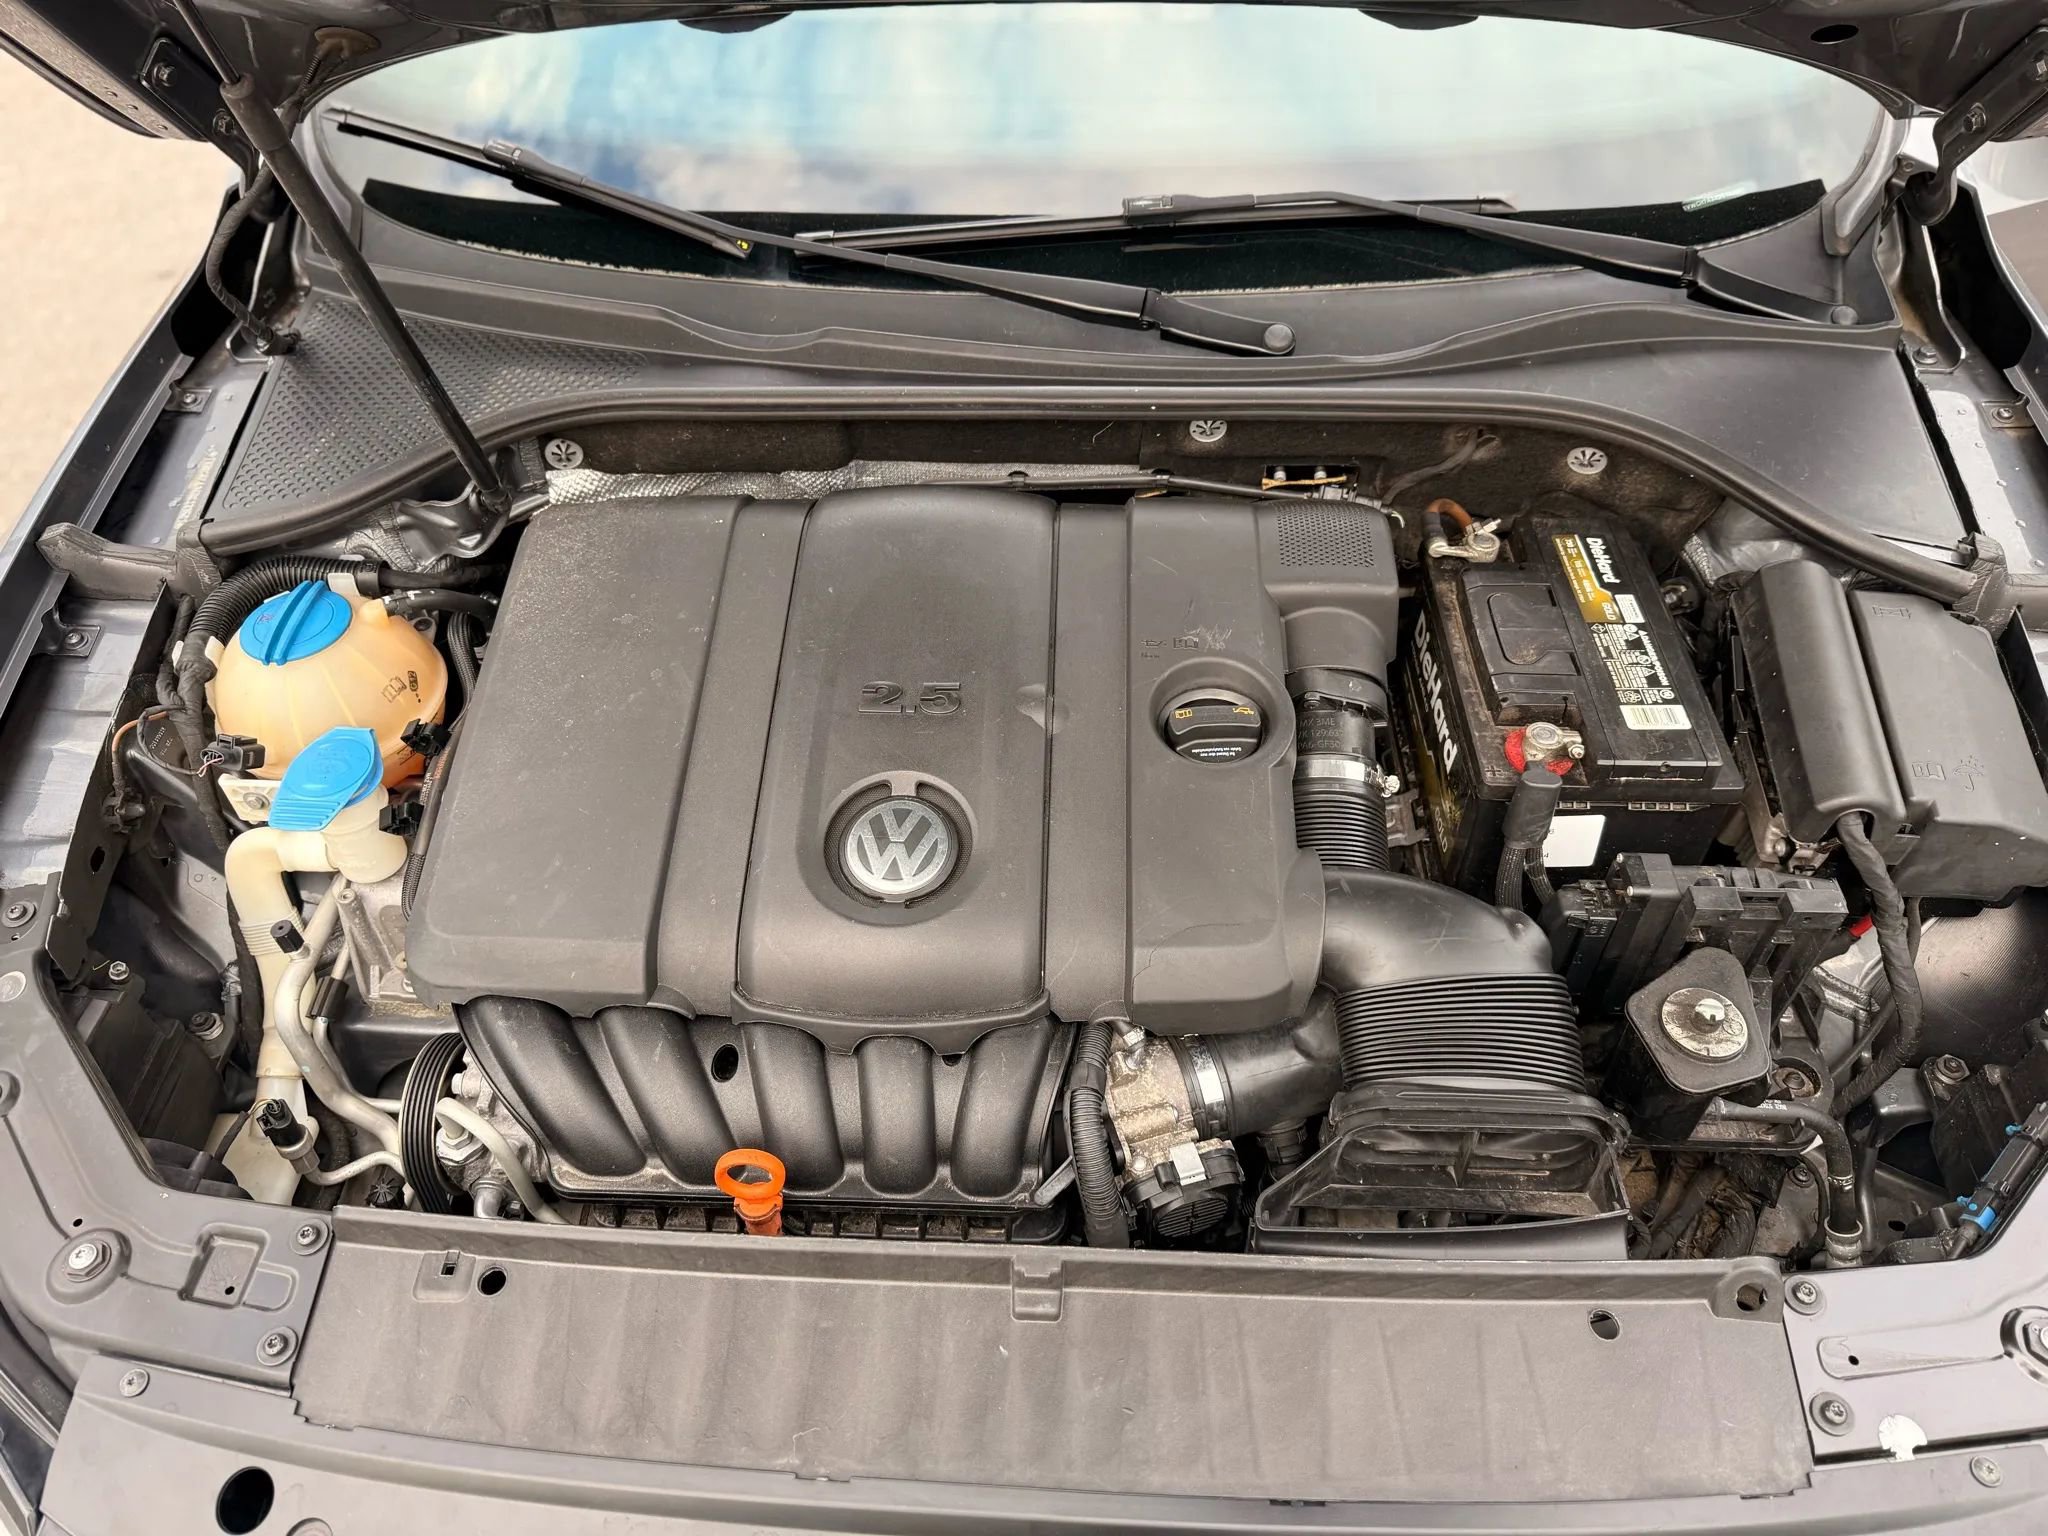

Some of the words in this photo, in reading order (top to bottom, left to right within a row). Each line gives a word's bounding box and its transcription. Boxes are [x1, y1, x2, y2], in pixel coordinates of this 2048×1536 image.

[1586, 537, 1621, 583] DieHard
[1602, 602, 1617, 620] GOLD
[858, 680, 961, 714] 2.5
[1414, 609, 1457, 775] DieHard
[848, 801, 947, 892] VW
[1433, 806, 1447, 853] GOLD
